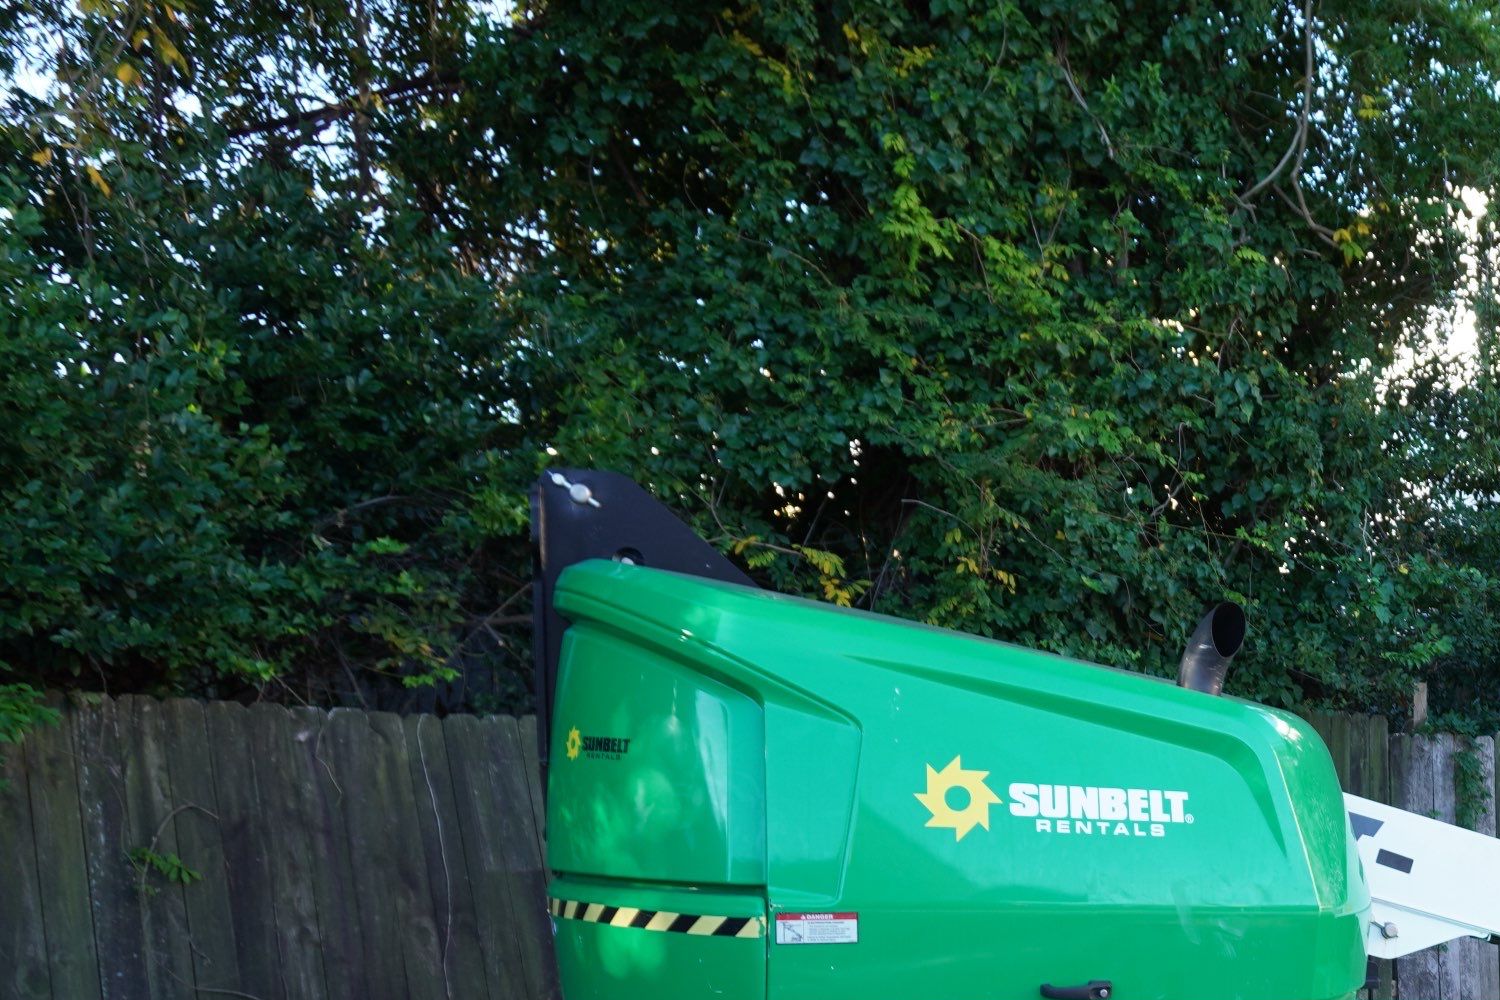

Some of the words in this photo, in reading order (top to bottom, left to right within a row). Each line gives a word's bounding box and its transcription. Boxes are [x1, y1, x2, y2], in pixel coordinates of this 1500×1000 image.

[582, 735, 631, 754] SUNBELT
[1035, 818, 1166, 838] RENTALS
[806, 913, 834, 921] DANGER
